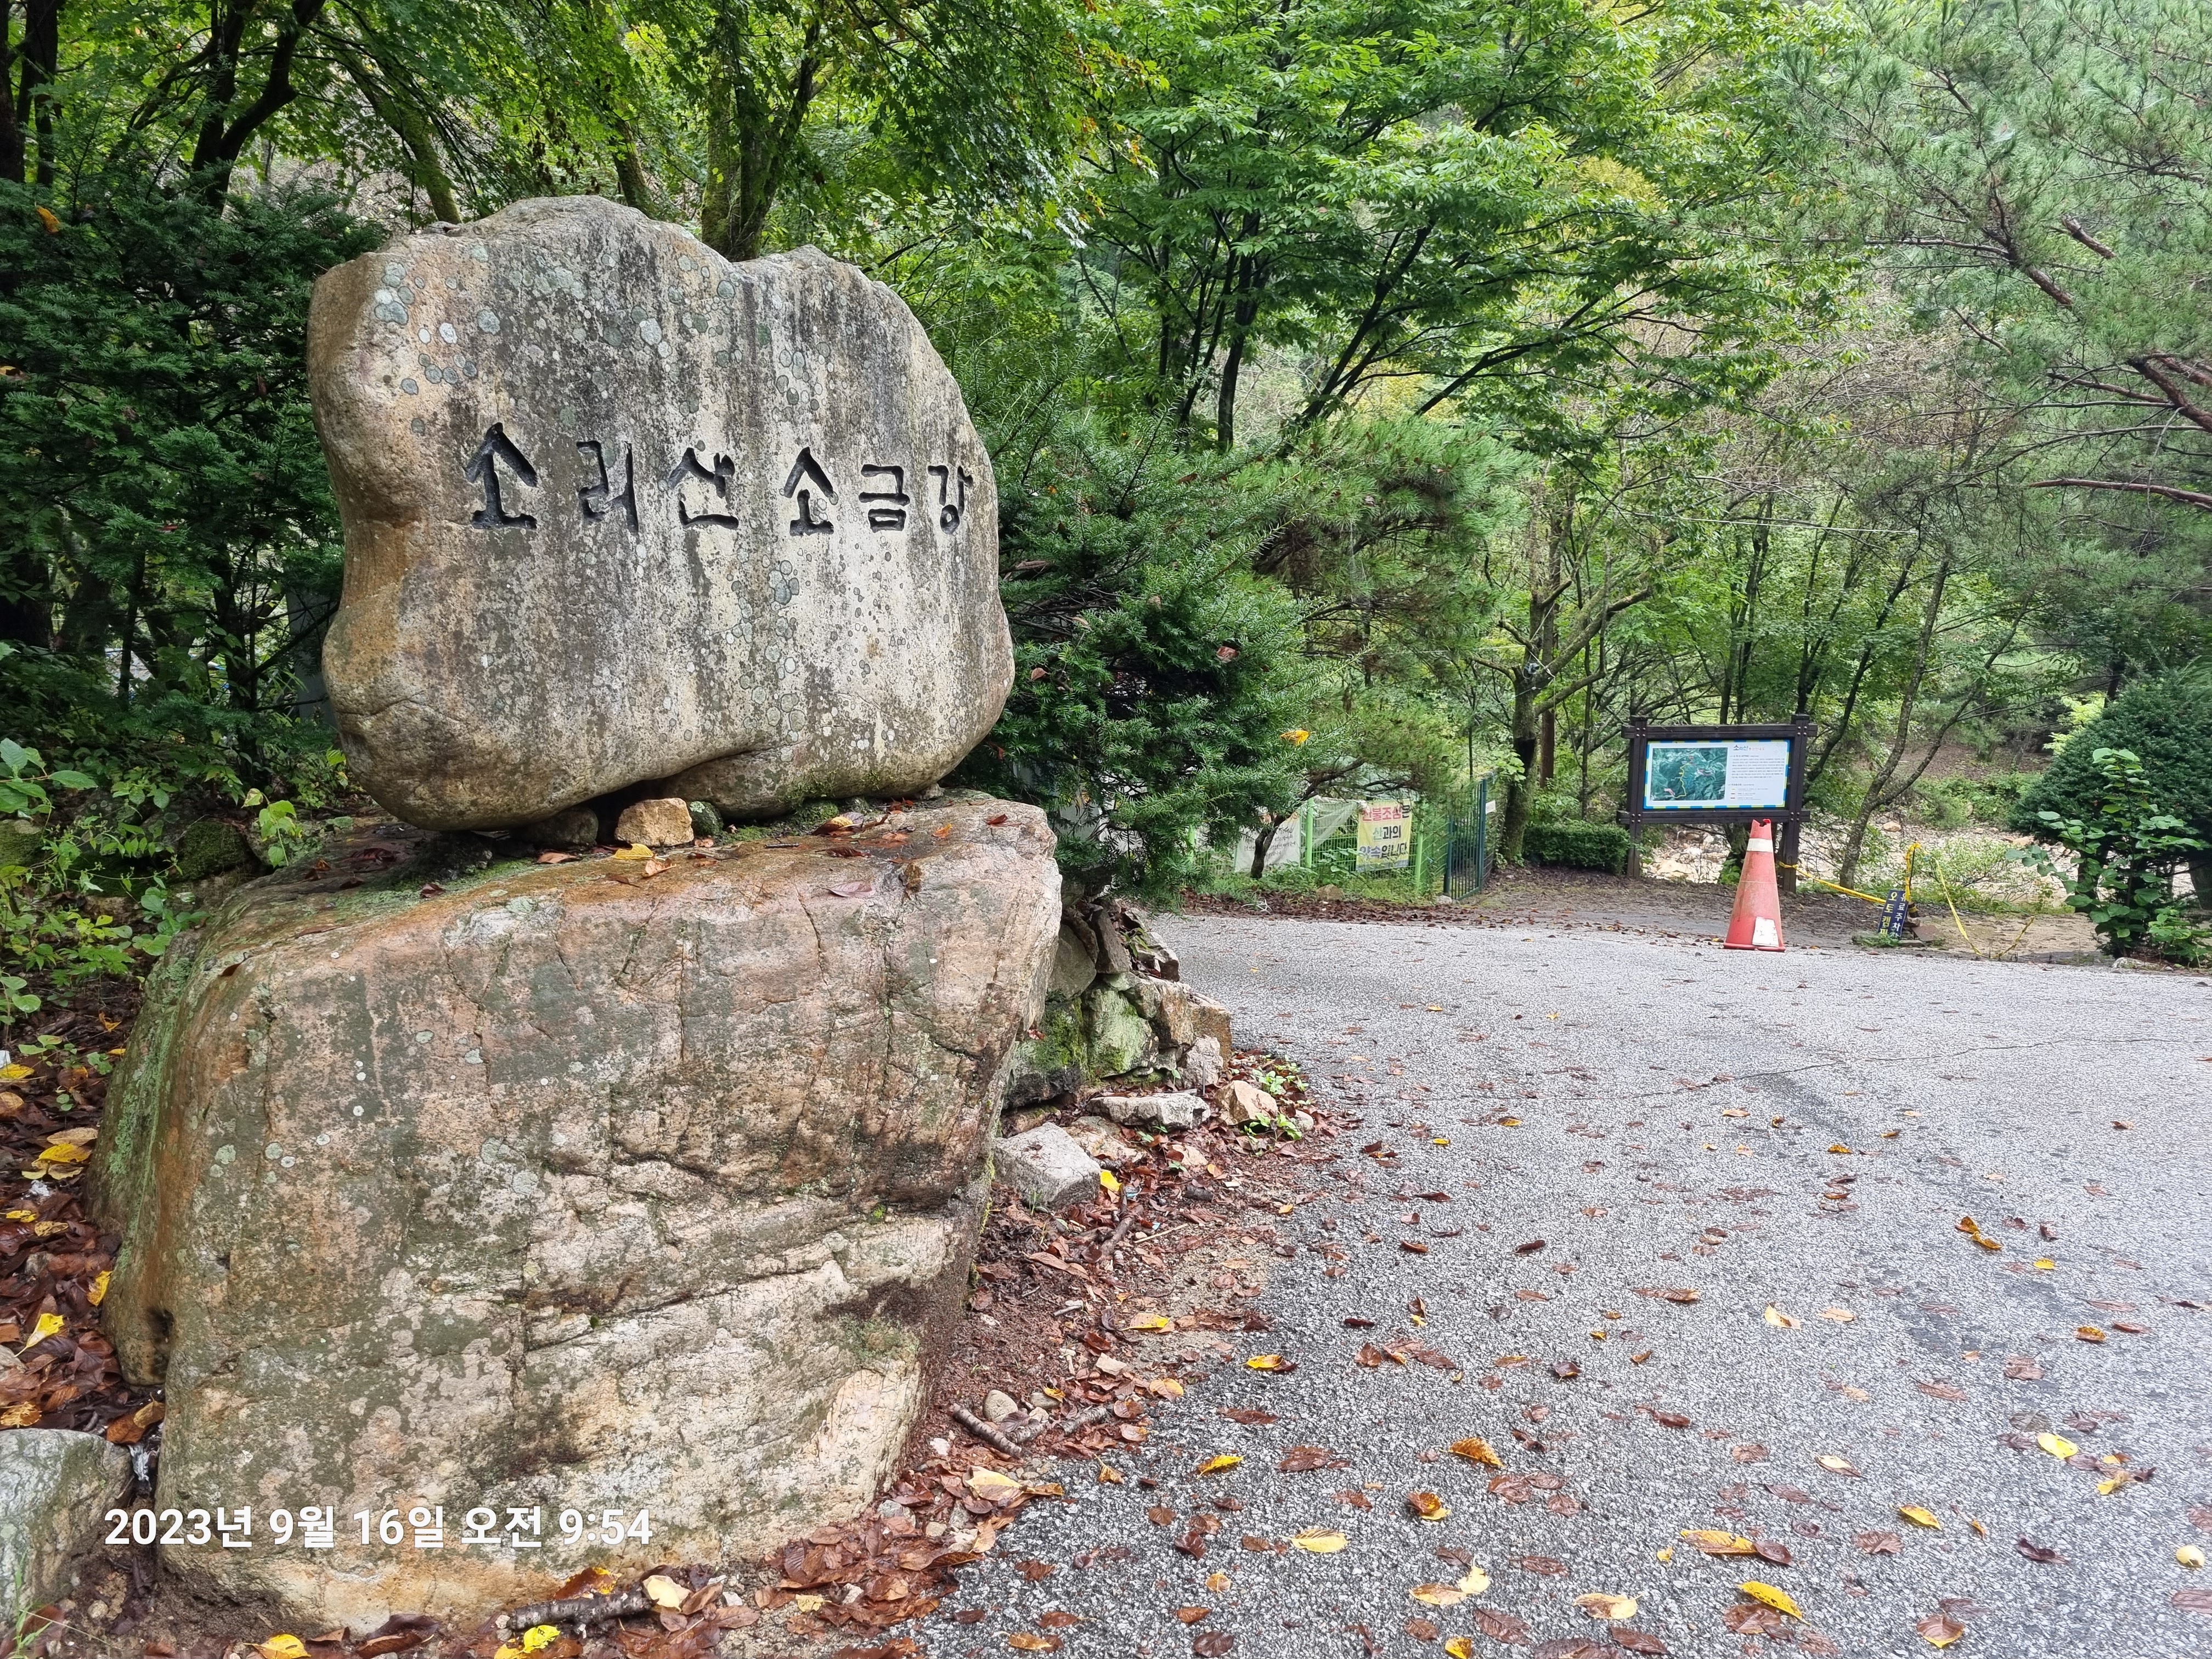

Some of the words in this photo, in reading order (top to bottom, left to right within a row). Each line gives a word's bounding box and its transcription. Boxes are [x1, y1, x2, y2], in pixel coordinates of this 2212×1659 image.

[784, 445, 974, 537] 소금강
[1361, 804, 1411, 822] 산불조심은
[1373, 825, 1402, 840] 산과의
[1359, 842, 1408, 859] 약속입니다
